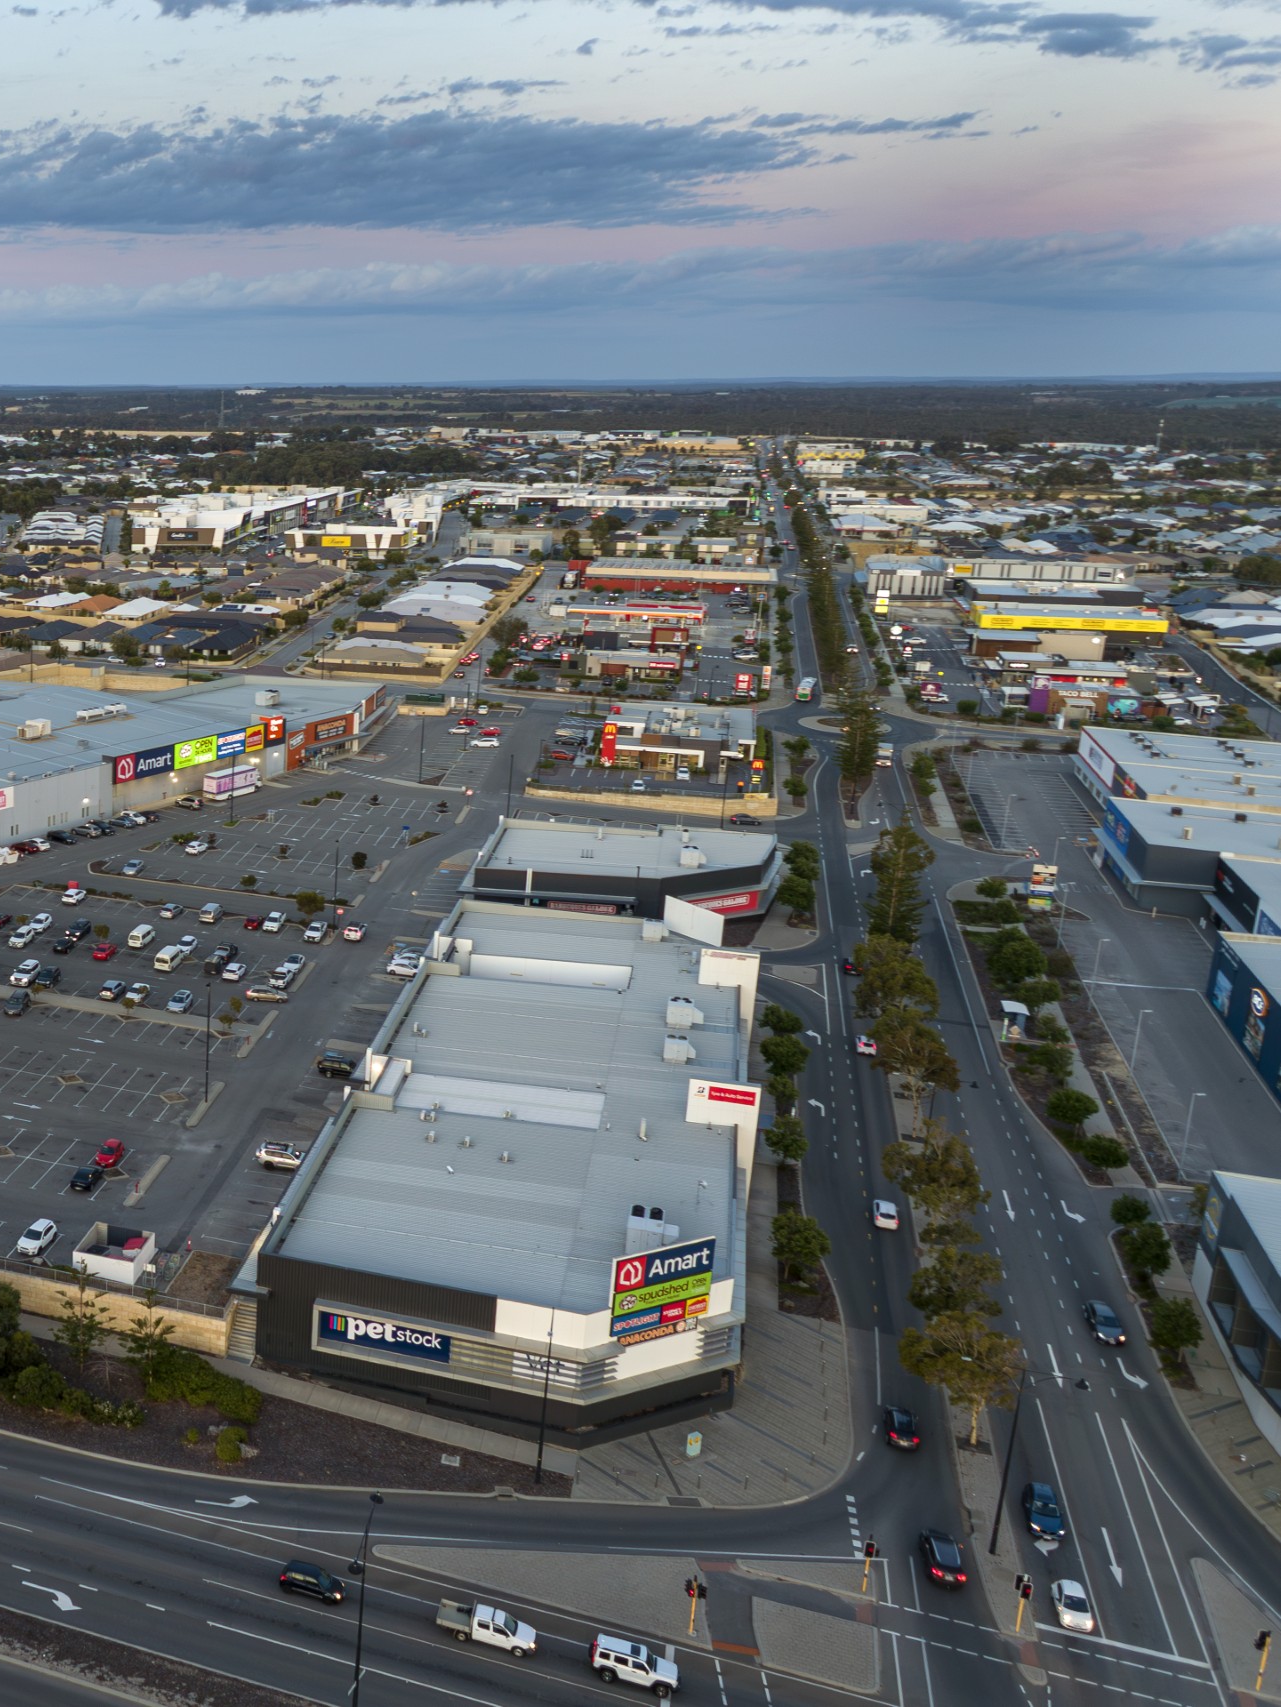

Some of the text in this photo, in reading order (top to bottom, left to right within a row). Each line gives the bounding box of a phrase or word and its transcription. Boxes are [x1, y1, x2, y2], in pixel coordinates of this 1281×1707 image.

[137, 753, 171, 772] Amart
[649, 1248, 710, 1278] Amart
[639, 1281, 689, 1303] spudshed
[613, 1313, 659, 1331] SPOTLIGHT
